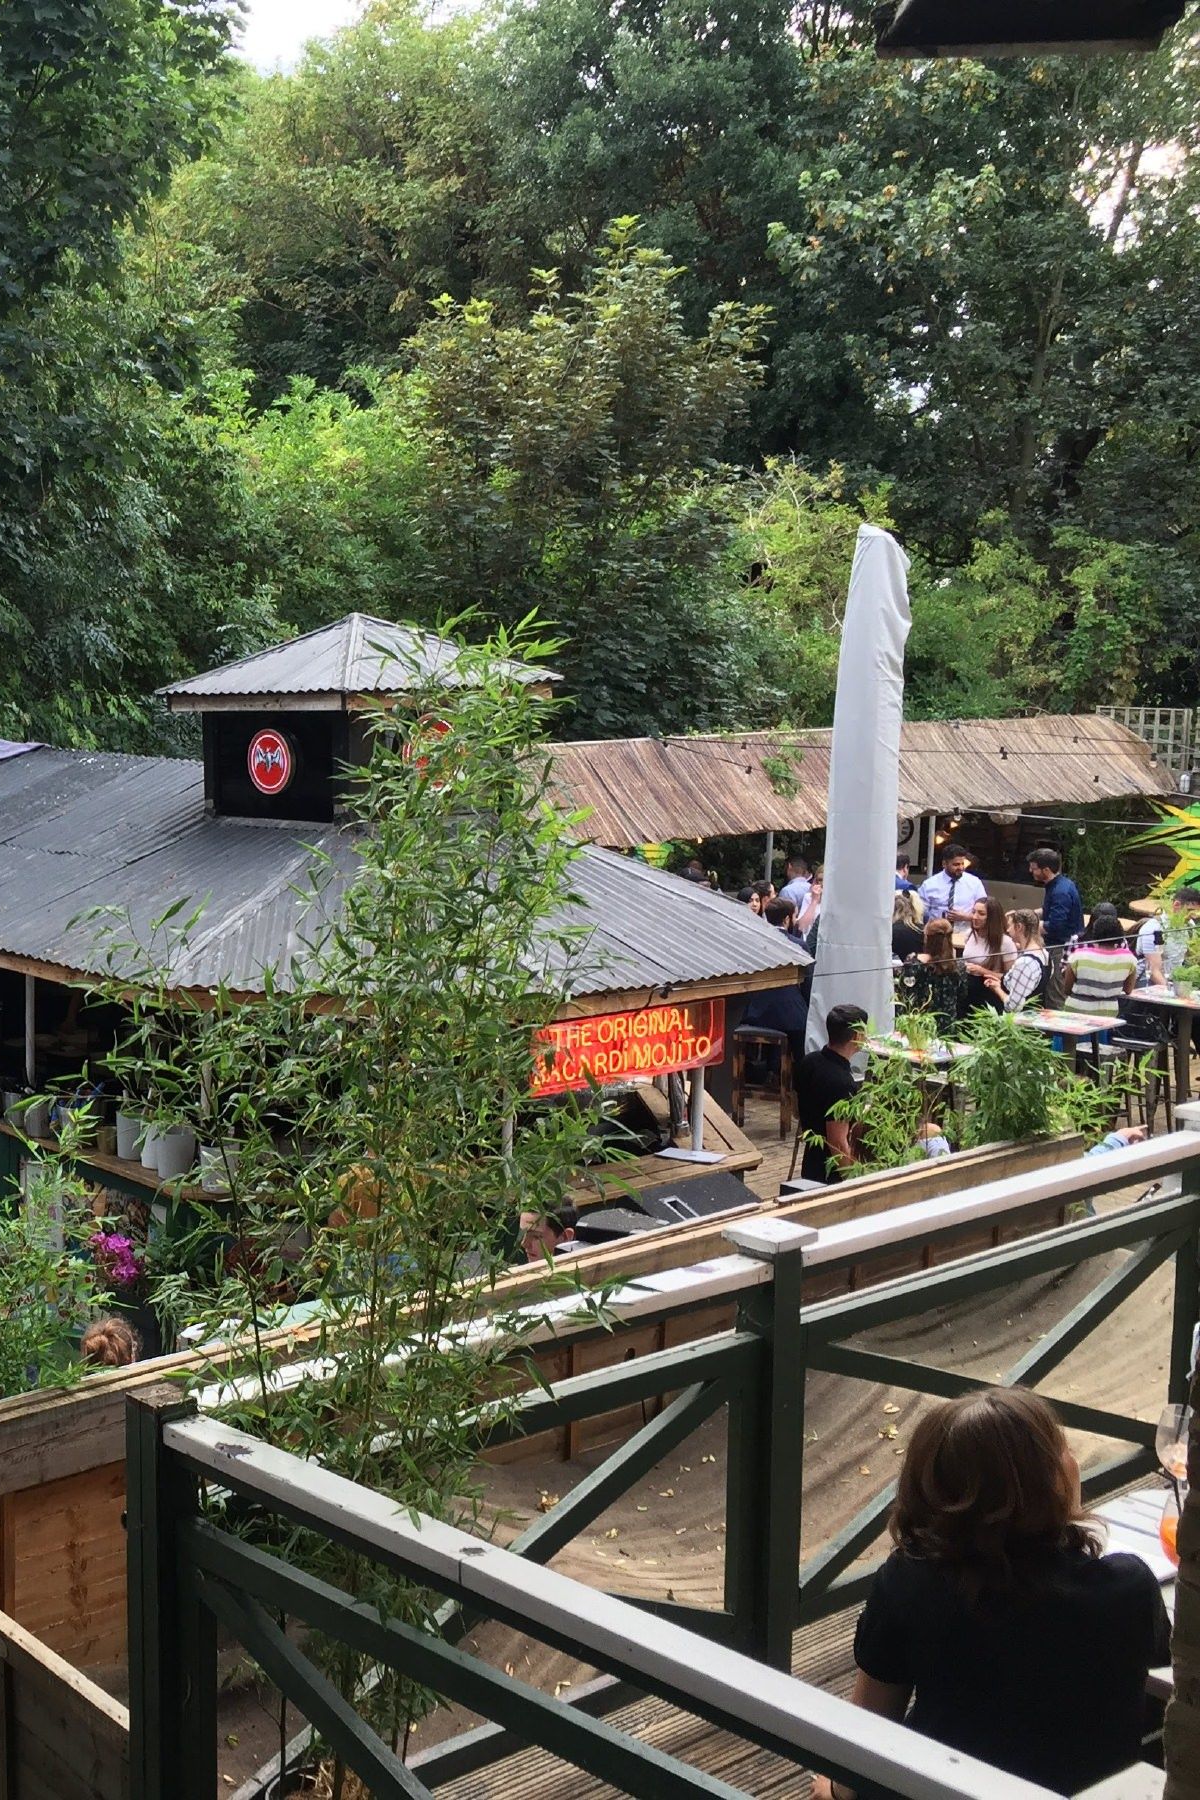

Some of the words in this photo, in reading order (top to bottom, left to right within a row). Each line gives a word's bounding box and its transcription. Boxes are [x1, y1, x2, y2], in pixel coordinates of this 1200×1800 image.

[549, 1023, 592, 1052] THE
[597, 1008, 694, 1044] ORIGINAL
[634, 1034, 711, 1070] MOJITO
